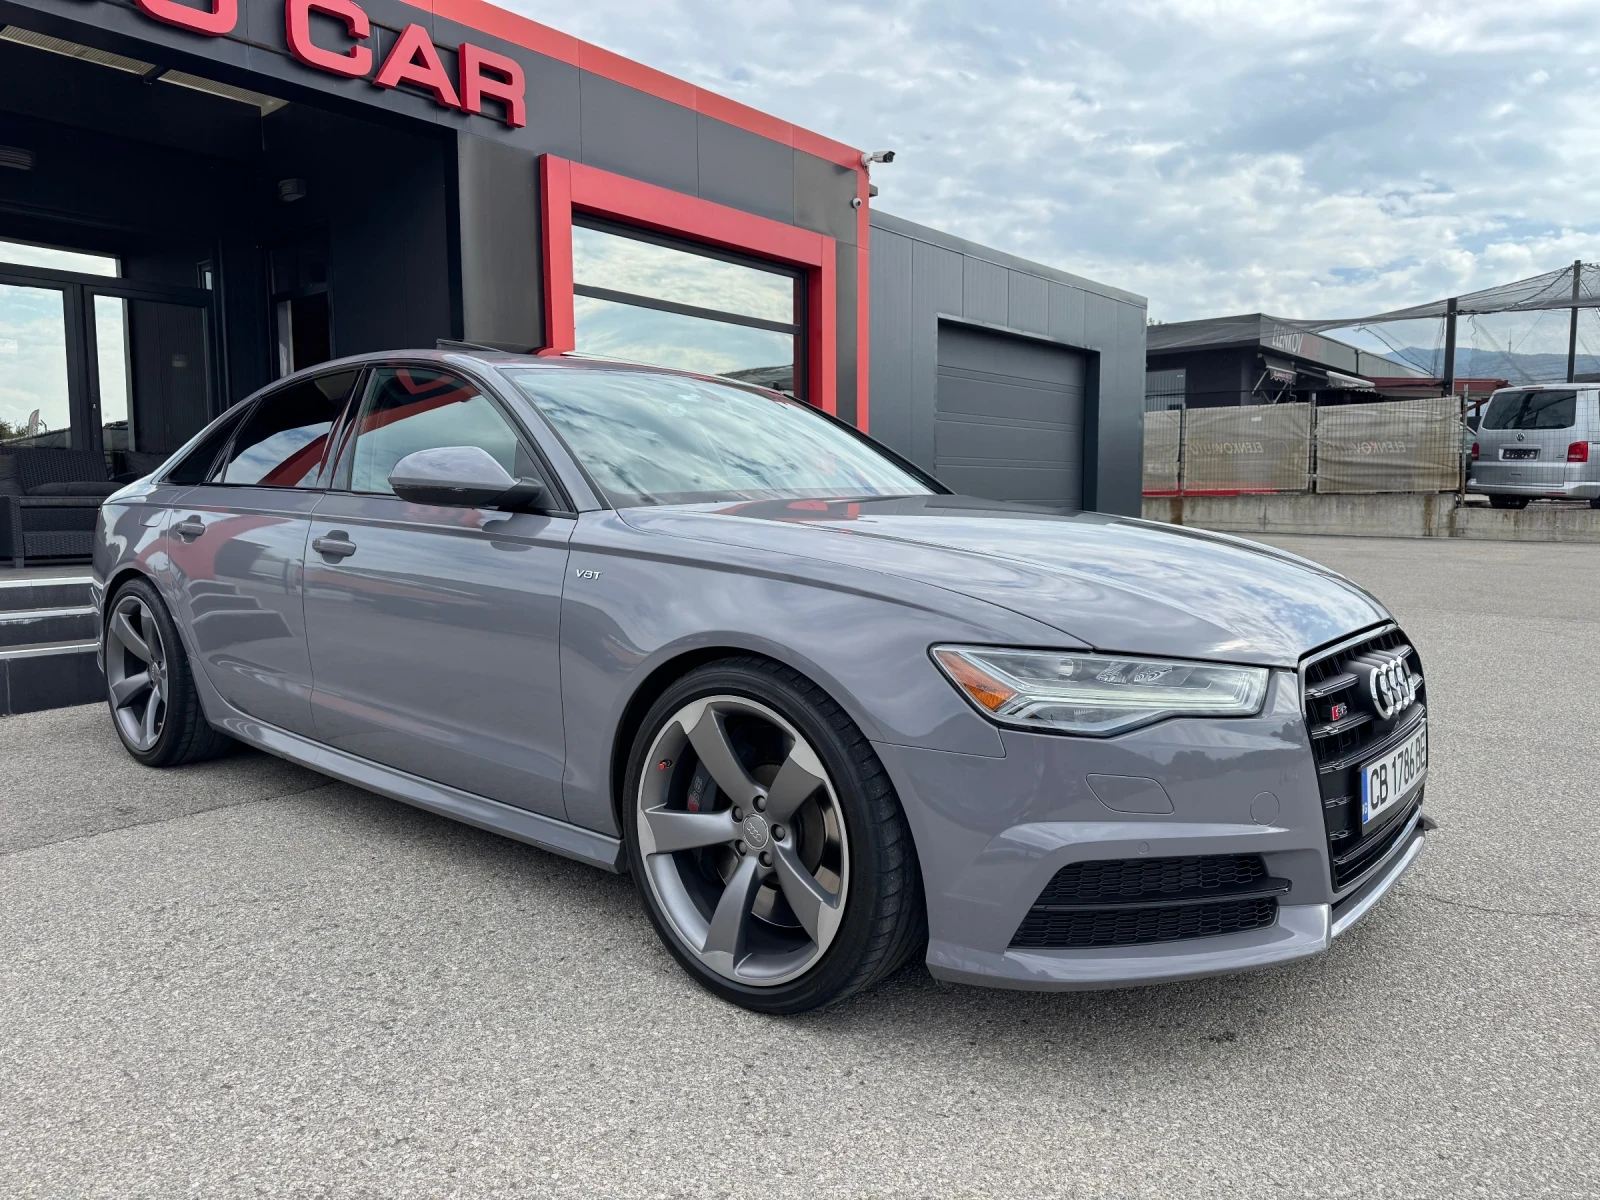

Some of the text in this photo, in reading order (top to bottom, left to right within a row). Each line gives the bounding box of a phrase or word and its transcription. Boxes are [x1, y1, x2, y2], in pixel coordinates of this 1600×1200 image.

[285, 0, 526, 129] CAR
[576, 568, 603, 581] V8T
[1370, 730, 1425, 811] CB 1786 BE
